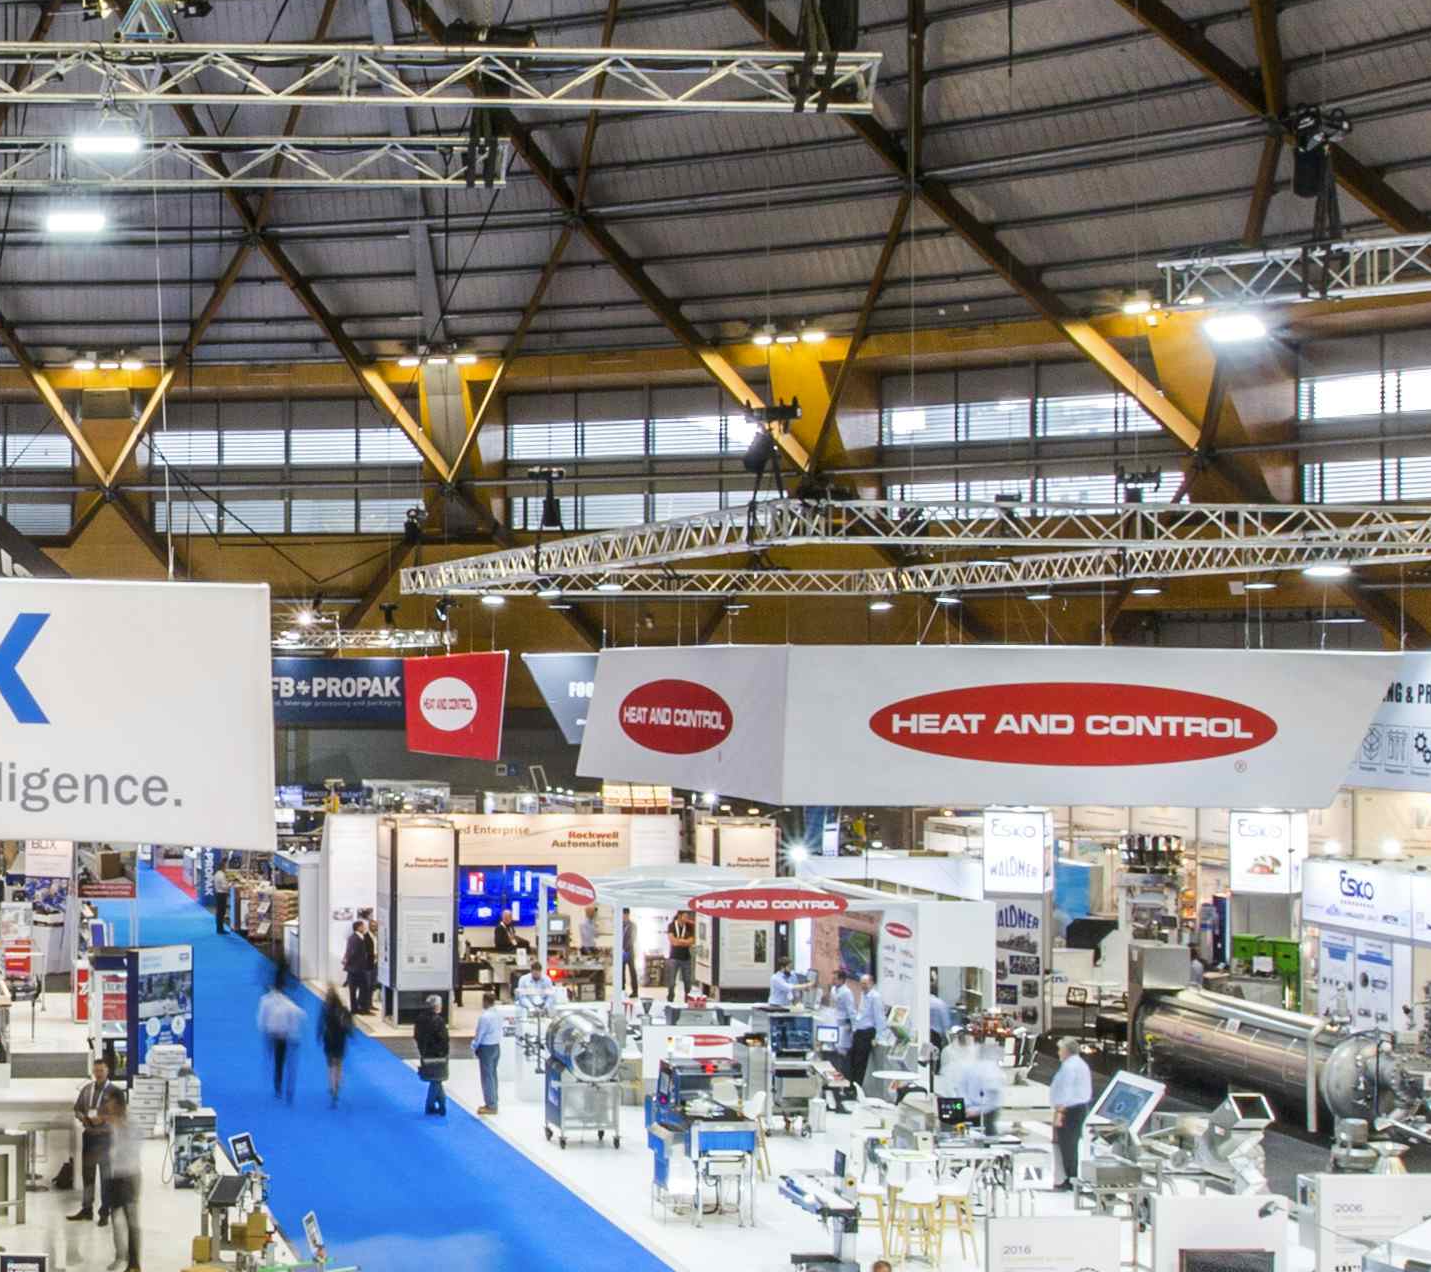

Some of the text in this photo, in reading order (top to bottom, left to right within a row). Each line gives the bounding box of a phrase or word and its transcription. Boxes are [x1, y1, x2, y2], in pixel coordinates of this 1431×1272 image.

[623, 706, 726, 731] HEAT AND CONTROL
[892, 712, 1253, 740] HEAT AND CONTROL
[568, 830, 619, 840] Rockwell
[551, 840, 619, 849] Automation
[695, 898, 840, 911] HEAT AND CONTROL
